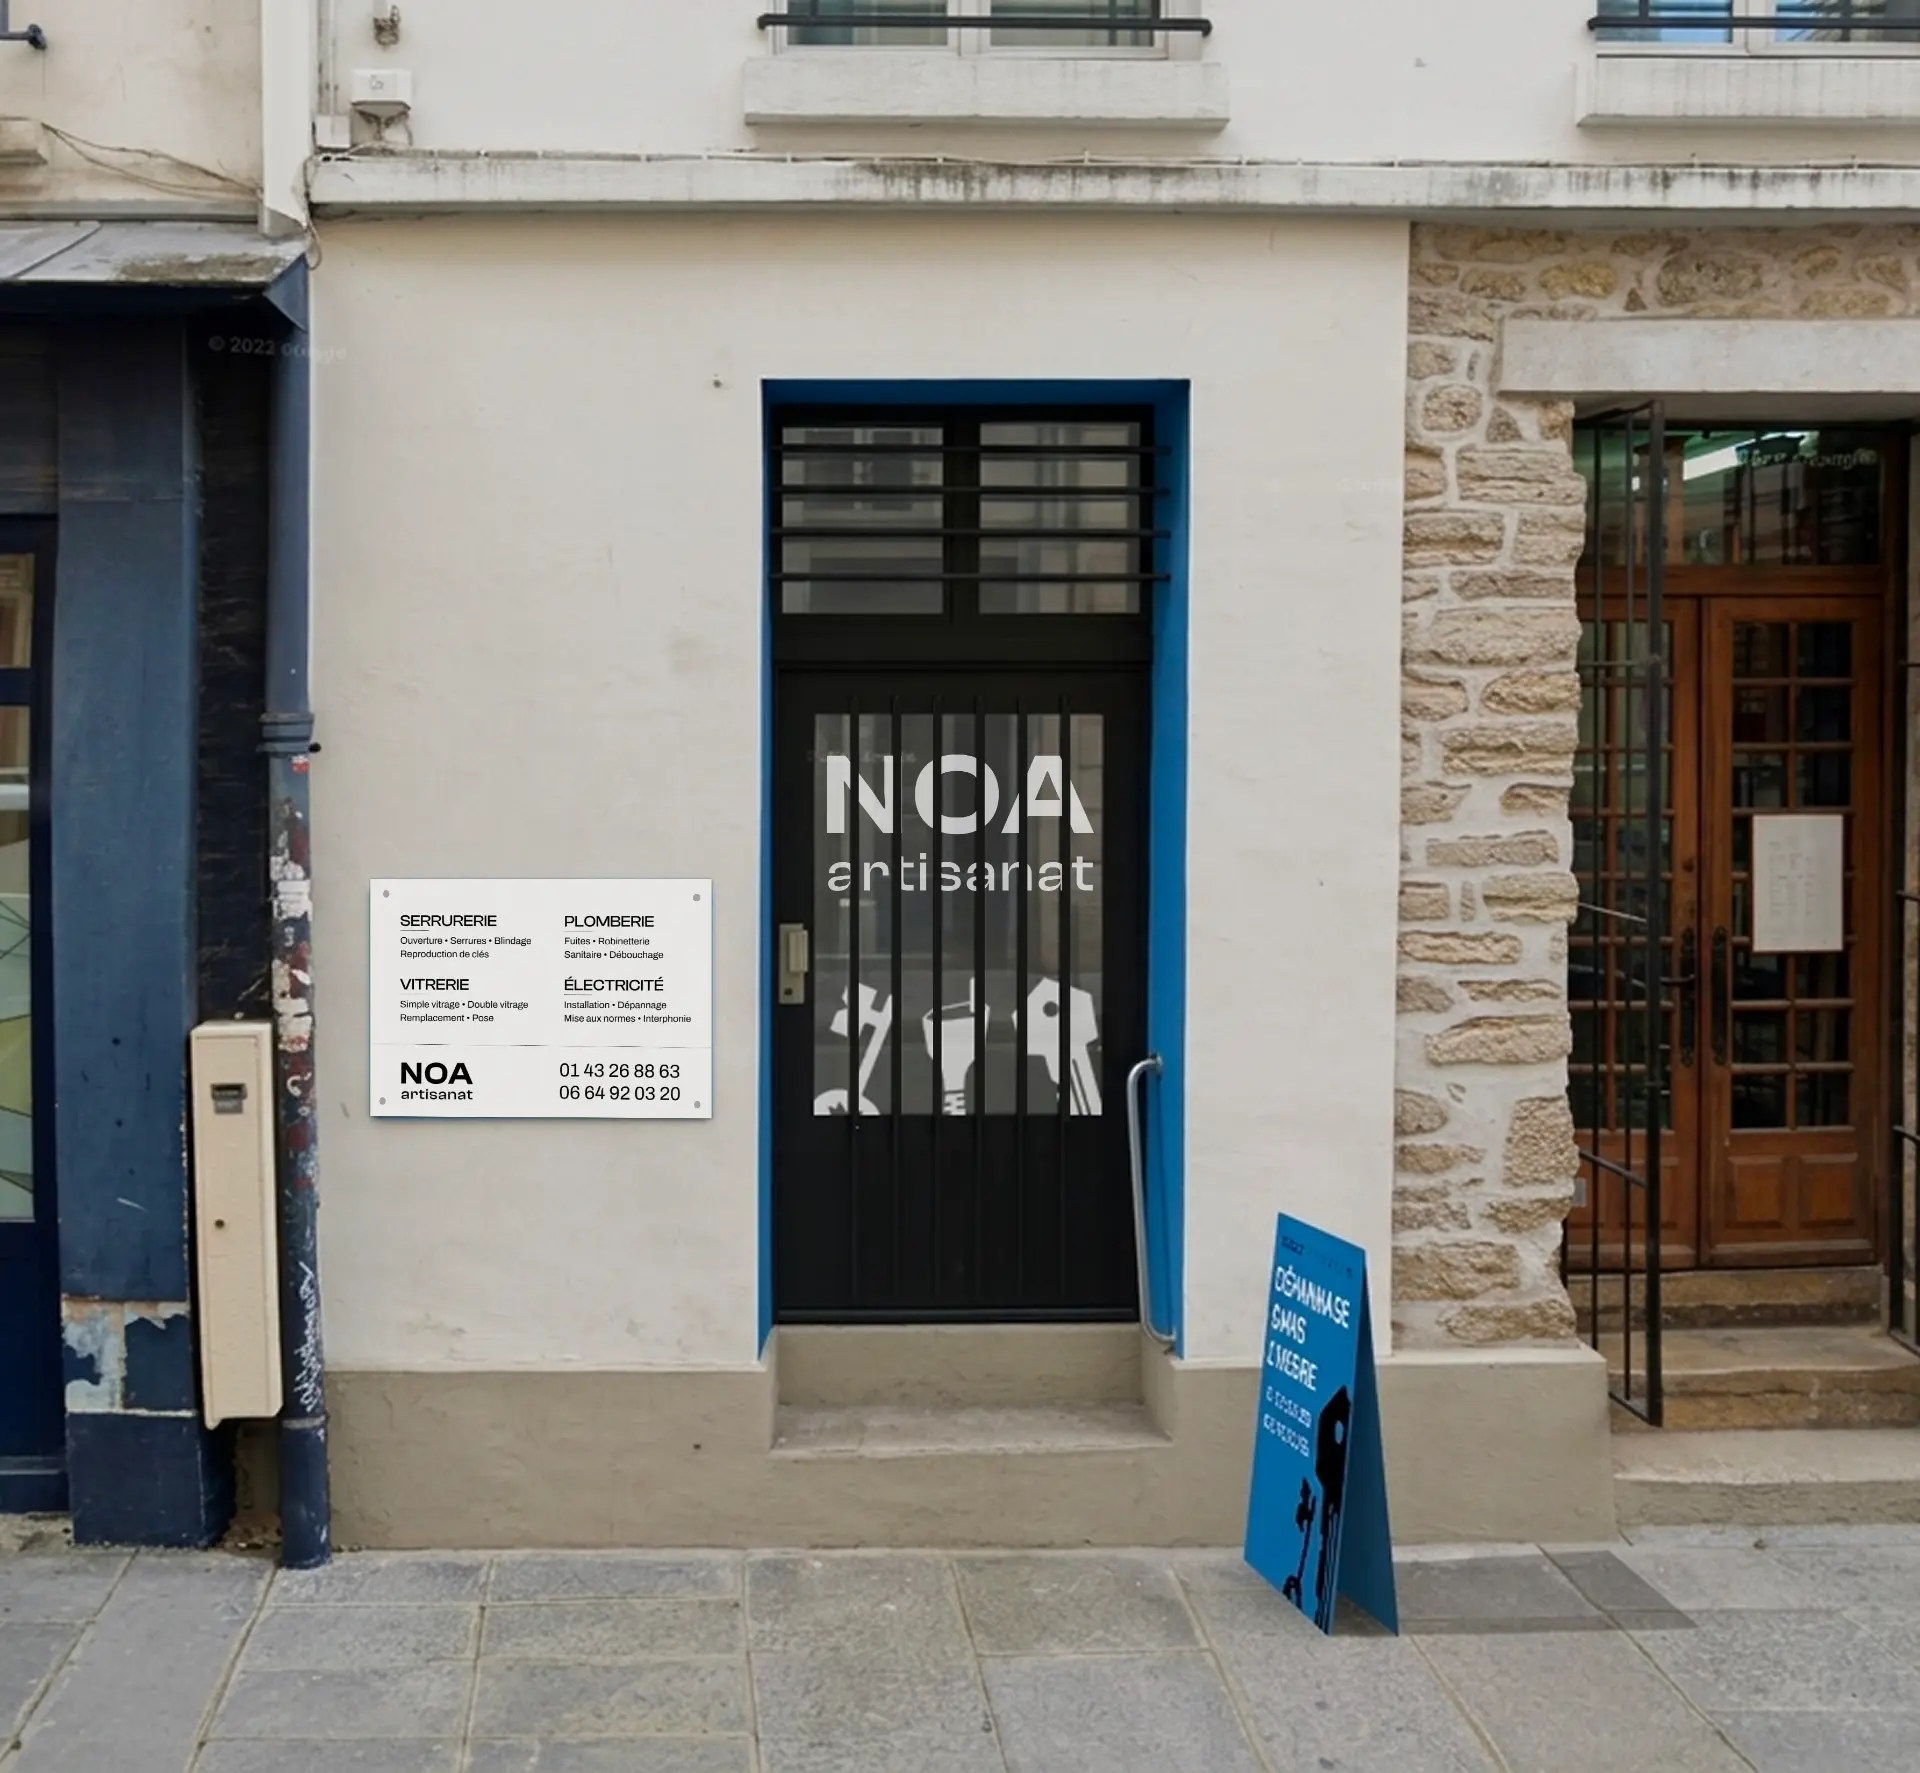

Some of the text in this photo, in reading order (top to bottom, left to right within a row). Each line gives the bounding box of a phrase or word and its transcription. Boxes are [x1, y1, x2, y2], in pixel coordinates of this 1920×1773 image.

[827, 754, 1094, 834] NOA
[827, 853, 1094, 891] artisanat
[399, 914, 498, 927] SERRURERIE
[564, 915, 655, 928] PLOMBERIE
[399, 936, 532, 947] Ouverture Serrures Blindage
[564, 936, 650, 946] Fuites Robinetterie
[400, 949, 490, 960] Reproduction de clés
[563, 949, 664, 961] Sanitaire Débouchage
[399, 978, 470, 991] VITRERIE
[564, 975, 664, 992] ÉLECTRICITÉ
[399, 999, 529, 1011] Simple vitrage Double vitrage
[564, 1000, 667, 1011] Installation Dépannage
[400, 1013, 495, 1024] Remplacement Pose
[564, 1014, 692, 1024] Mise aux normes Interphonie
[400, 1061, 474, 1085] NOA
[559, 1062, 680, 1079] 01 43 26 88 63
[400, 1087, 474, 1101] artisanat
[559, 1085, 681, 1102] 06 64 92 03 20
